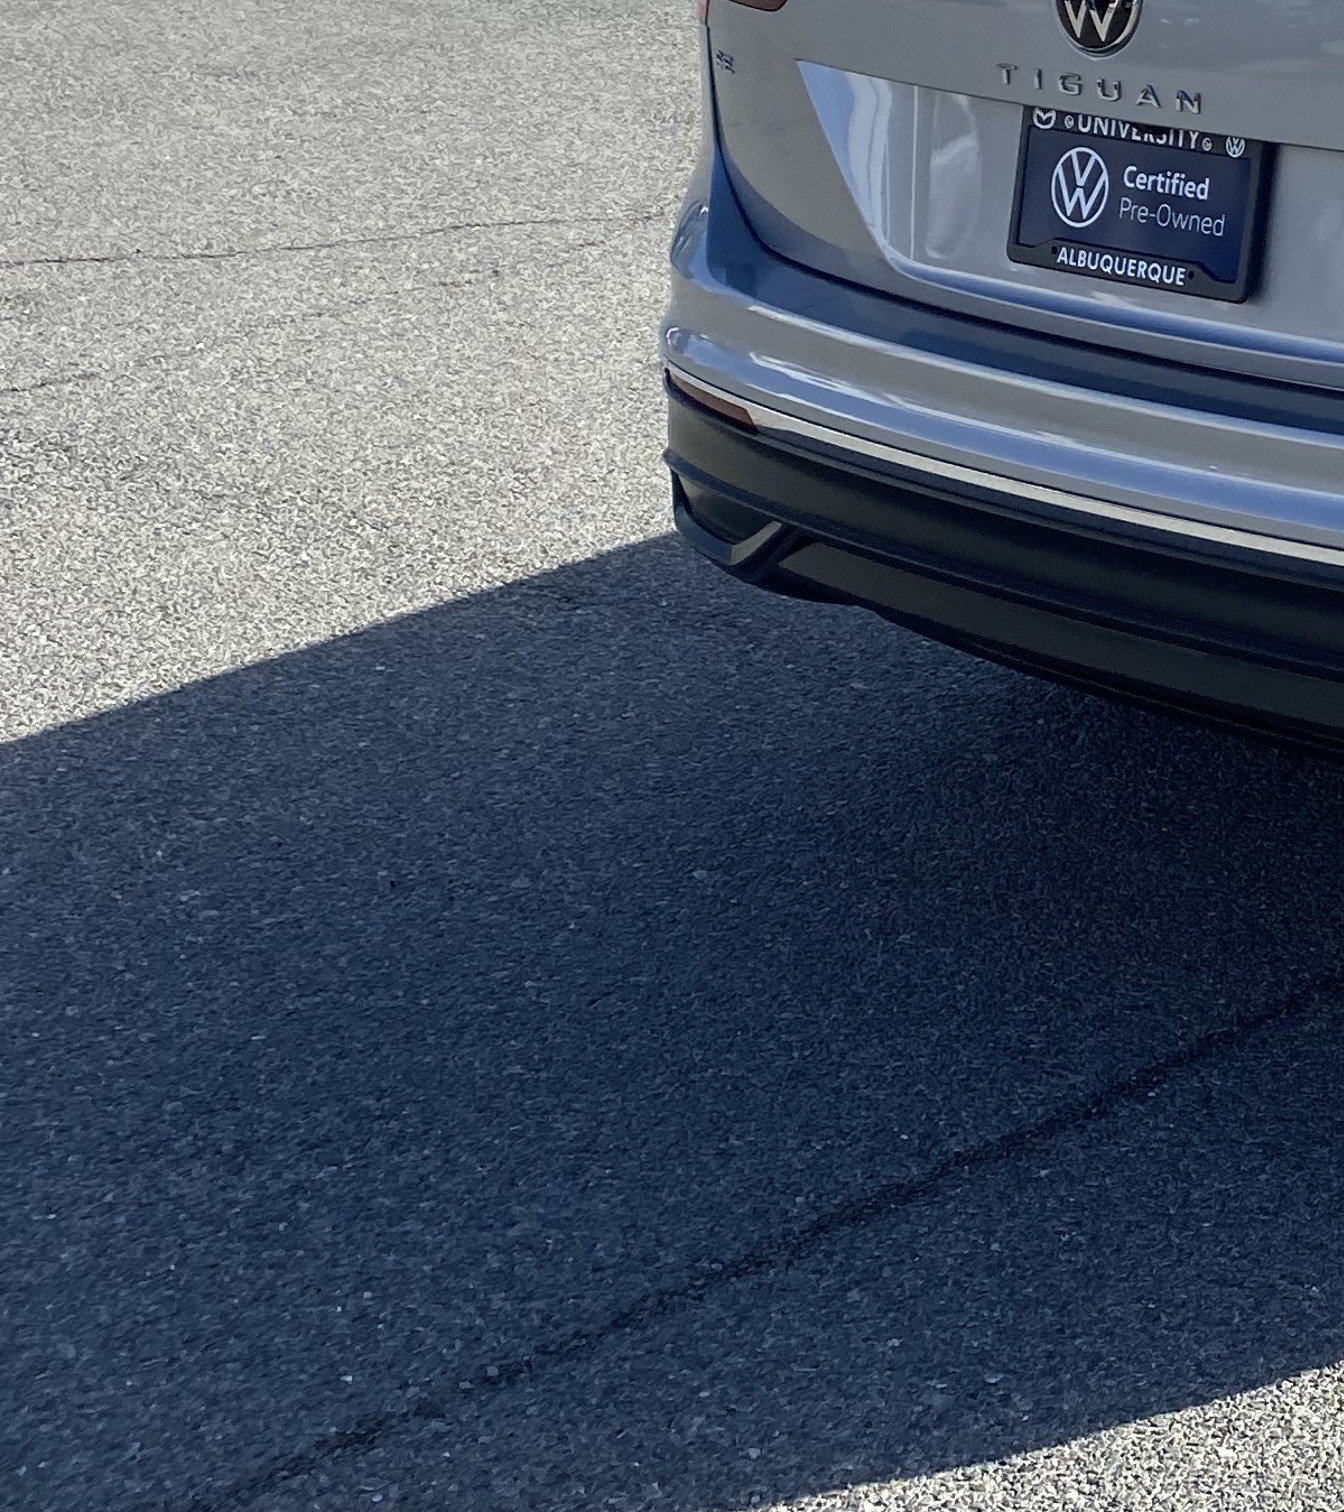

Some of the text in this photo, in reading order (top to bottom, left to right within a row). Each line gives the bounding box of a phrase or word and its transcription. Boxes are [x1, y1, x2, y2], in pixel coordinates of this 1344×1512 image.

[996, 62, 1202, 115] TIGUAN
[1124, 165, 1210, 200] Certified
[1119, 197, 1226, 236] Pre-Owned
[1057, 247, 1187, 286] ALBUQUERQUE
